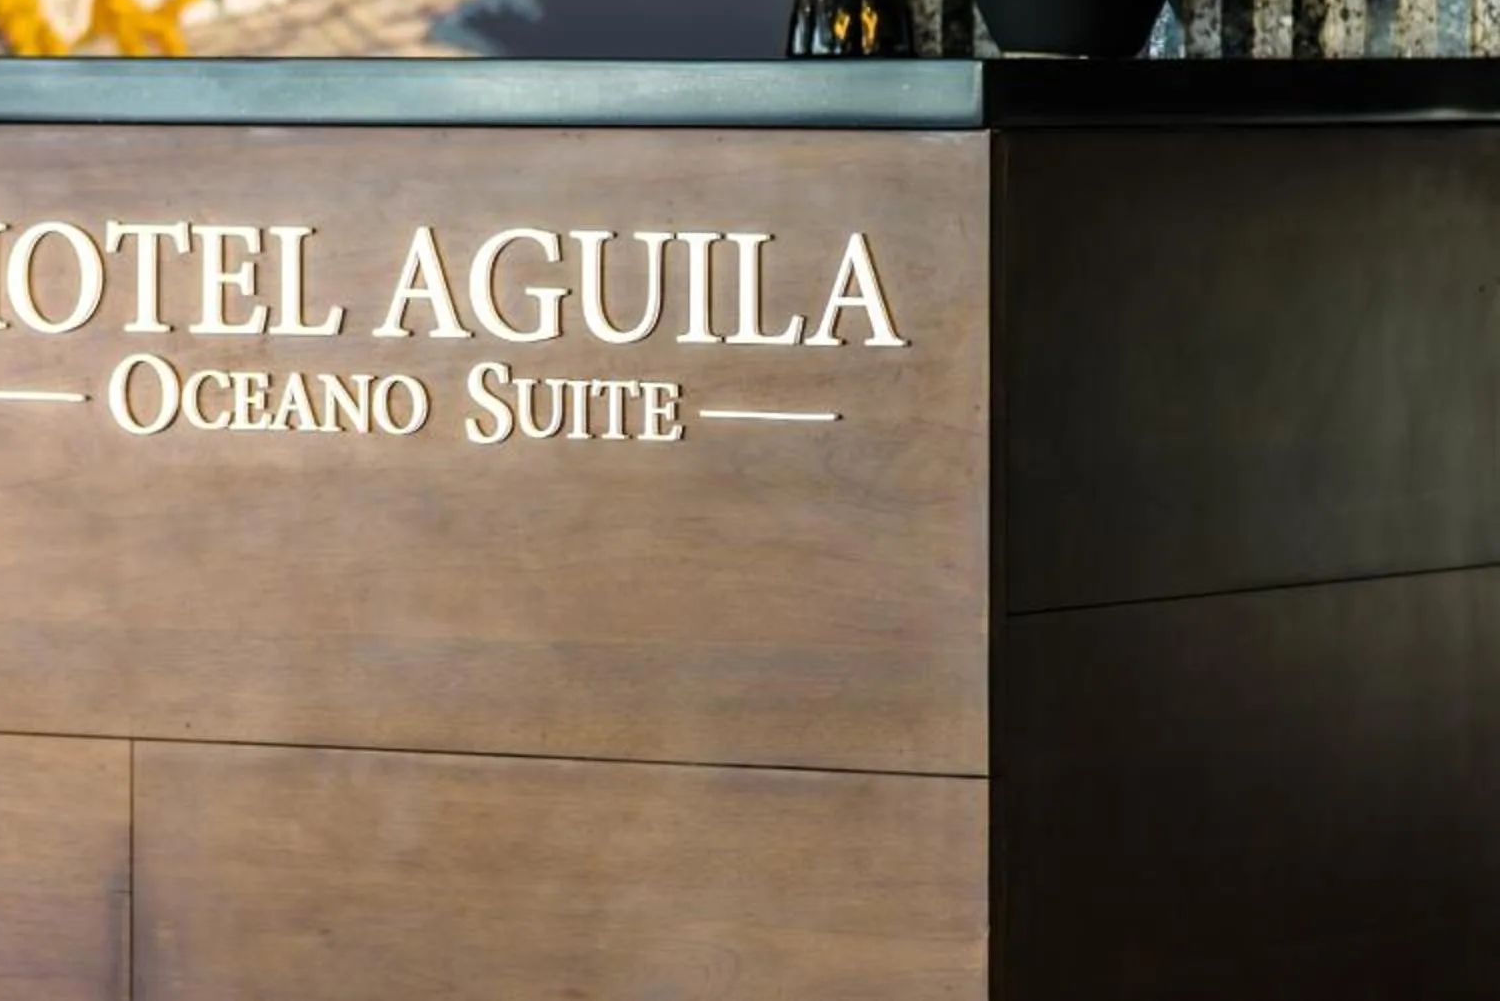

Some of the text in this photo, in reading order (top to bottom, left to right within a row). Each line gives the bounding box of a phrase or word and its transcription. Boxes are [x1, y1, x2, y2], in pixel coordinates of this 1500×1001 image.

[372, 225, 910, 348] AGUILA
[107, 353, 686, 444] OCEANO SUITE
